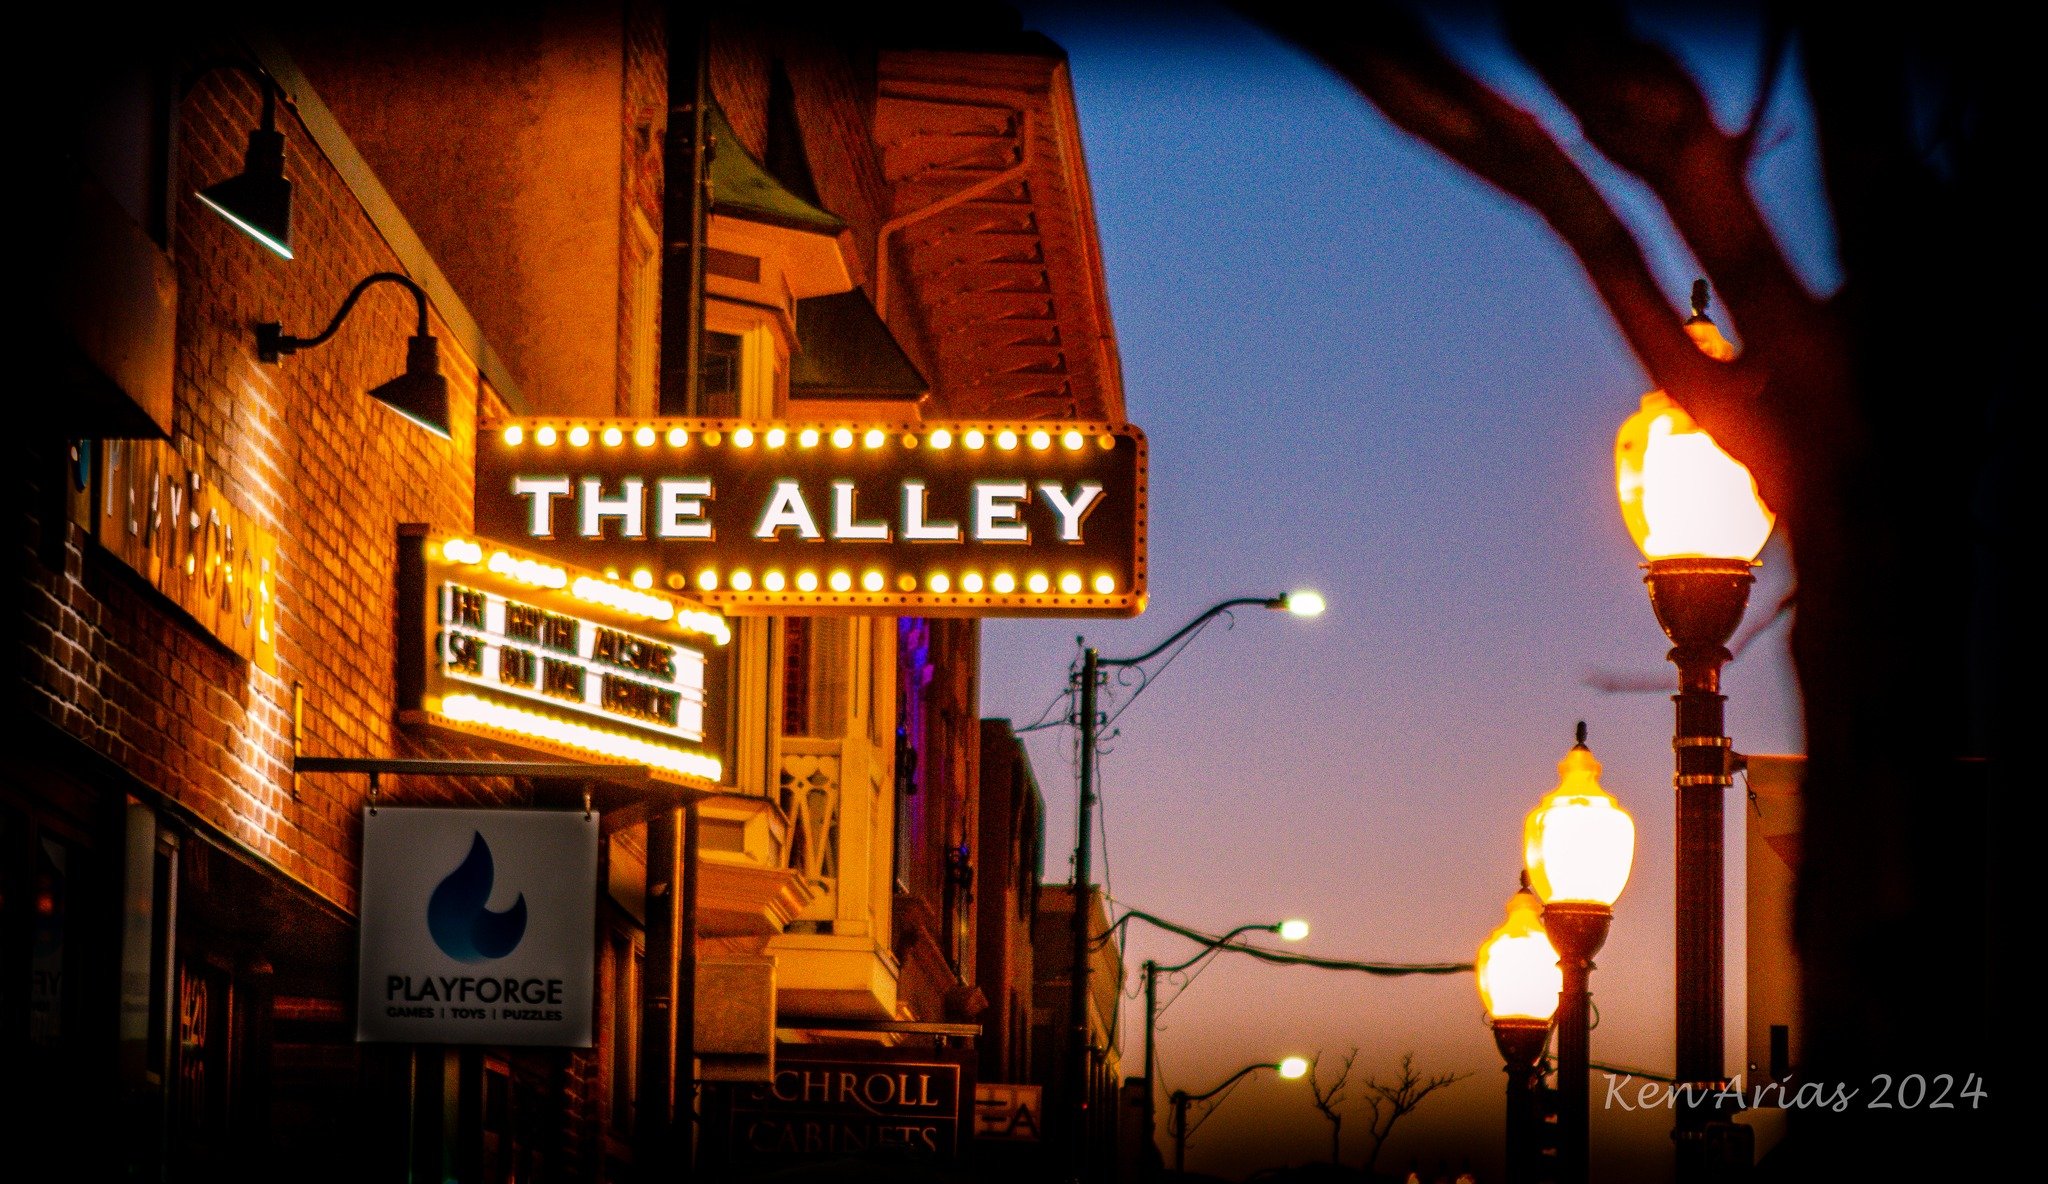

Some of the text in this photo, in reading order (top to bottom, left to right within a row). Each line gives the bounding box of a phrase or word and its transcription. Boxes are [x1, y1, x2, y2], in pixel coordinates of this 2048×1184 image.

[513, 476, 1105, 545] THE ALLEY
[387, 975, 563, 1005] PLAYFORGE
[386, 1006, 434, 1019] GAMES
[452, 1007, 486, 1020] TOYS
[503, 1009, 562, 1021] PUZZLES
[747, 1119, 939, 1153] CABINETS
